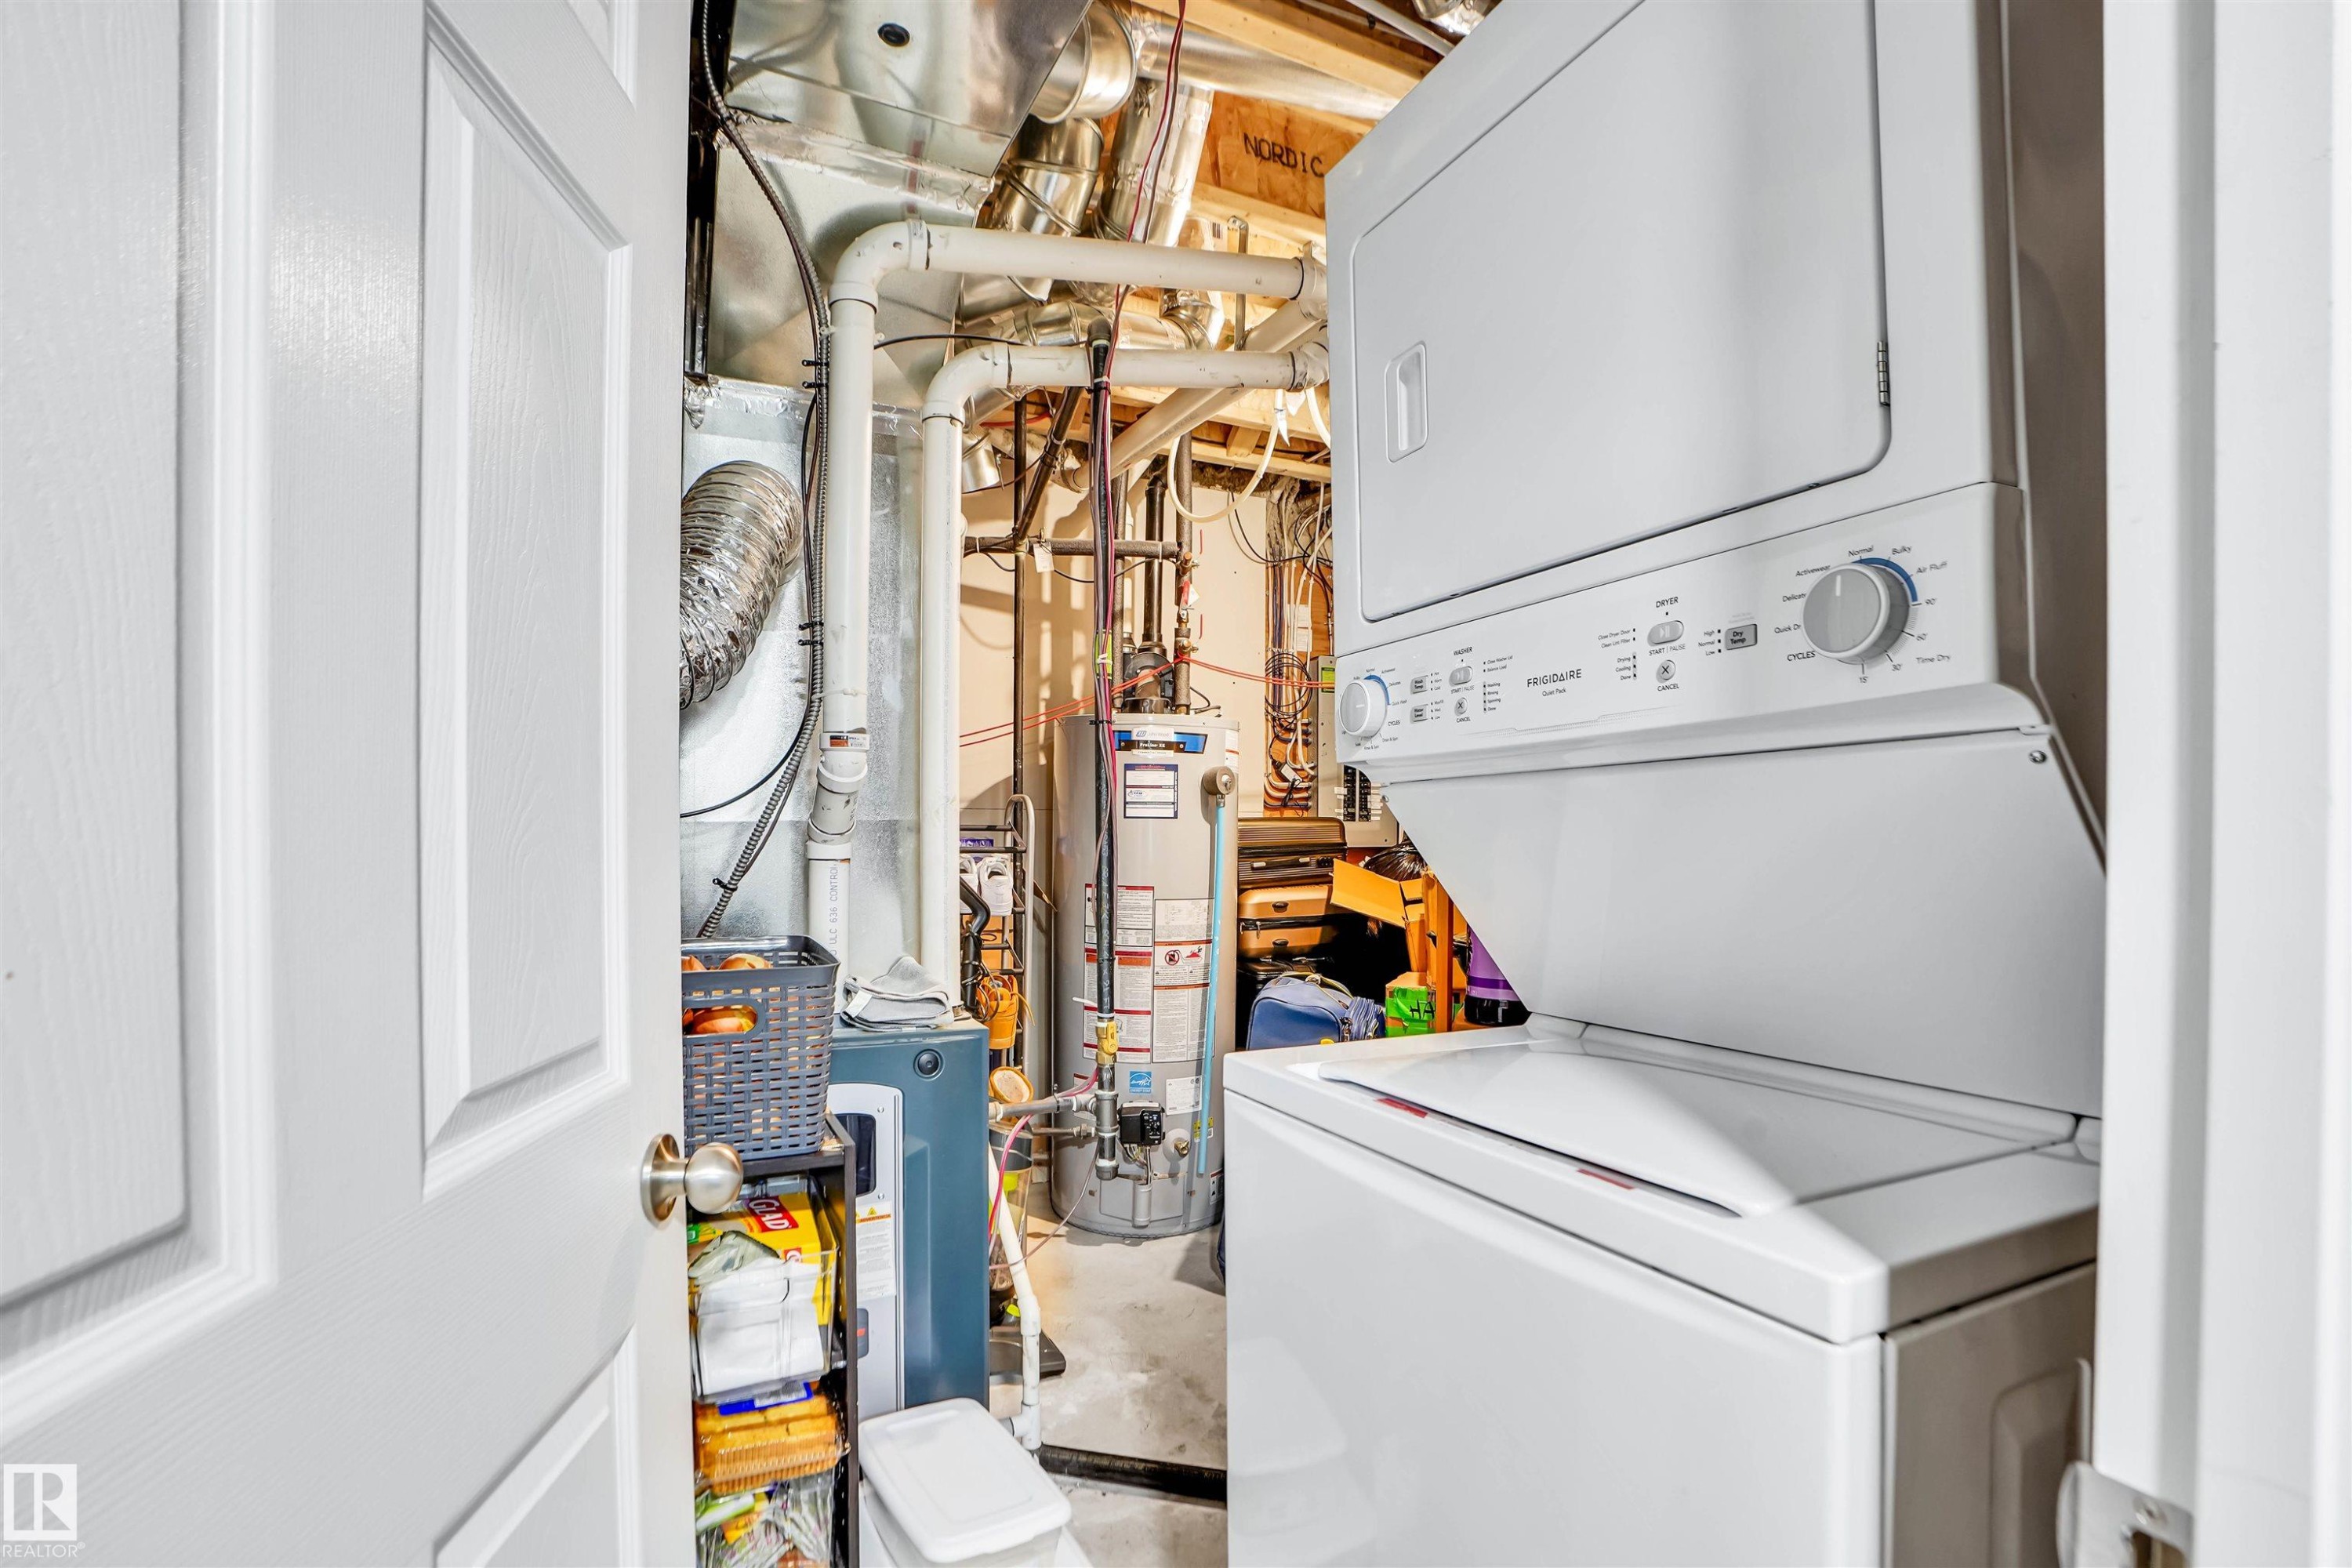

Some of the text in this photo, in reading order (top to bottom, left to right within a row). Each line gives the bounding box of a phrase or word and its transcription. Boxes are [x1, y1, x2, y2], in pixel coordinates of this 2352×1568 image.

[1243, 132, 1325, 178] NORDIC
[1847, 545, 1875, 557] Normal
[1892, 546, 1912, 555] Bulky
[1795, 564, 1831, 577] Activewear
[1916, 566, 1928, 575] Air
[1656, 597, 1679, 608] DRYER
[1774, 625, 1791, 633] Quick
[1454, 646, 1473, 656] WASHER
[1649, 644, 1686, 656] START PAUSE
[1787, 650, 1816, 662] CYCLES
[1937, 655, 1951, 663] Dry
[1527, 669, 1582, 688] FRIGIDAIRE
[829, 906, 838, 924] 636
[827, 928, 837, 946] ULC
[749, 1199, 790, 1229] GLAD
